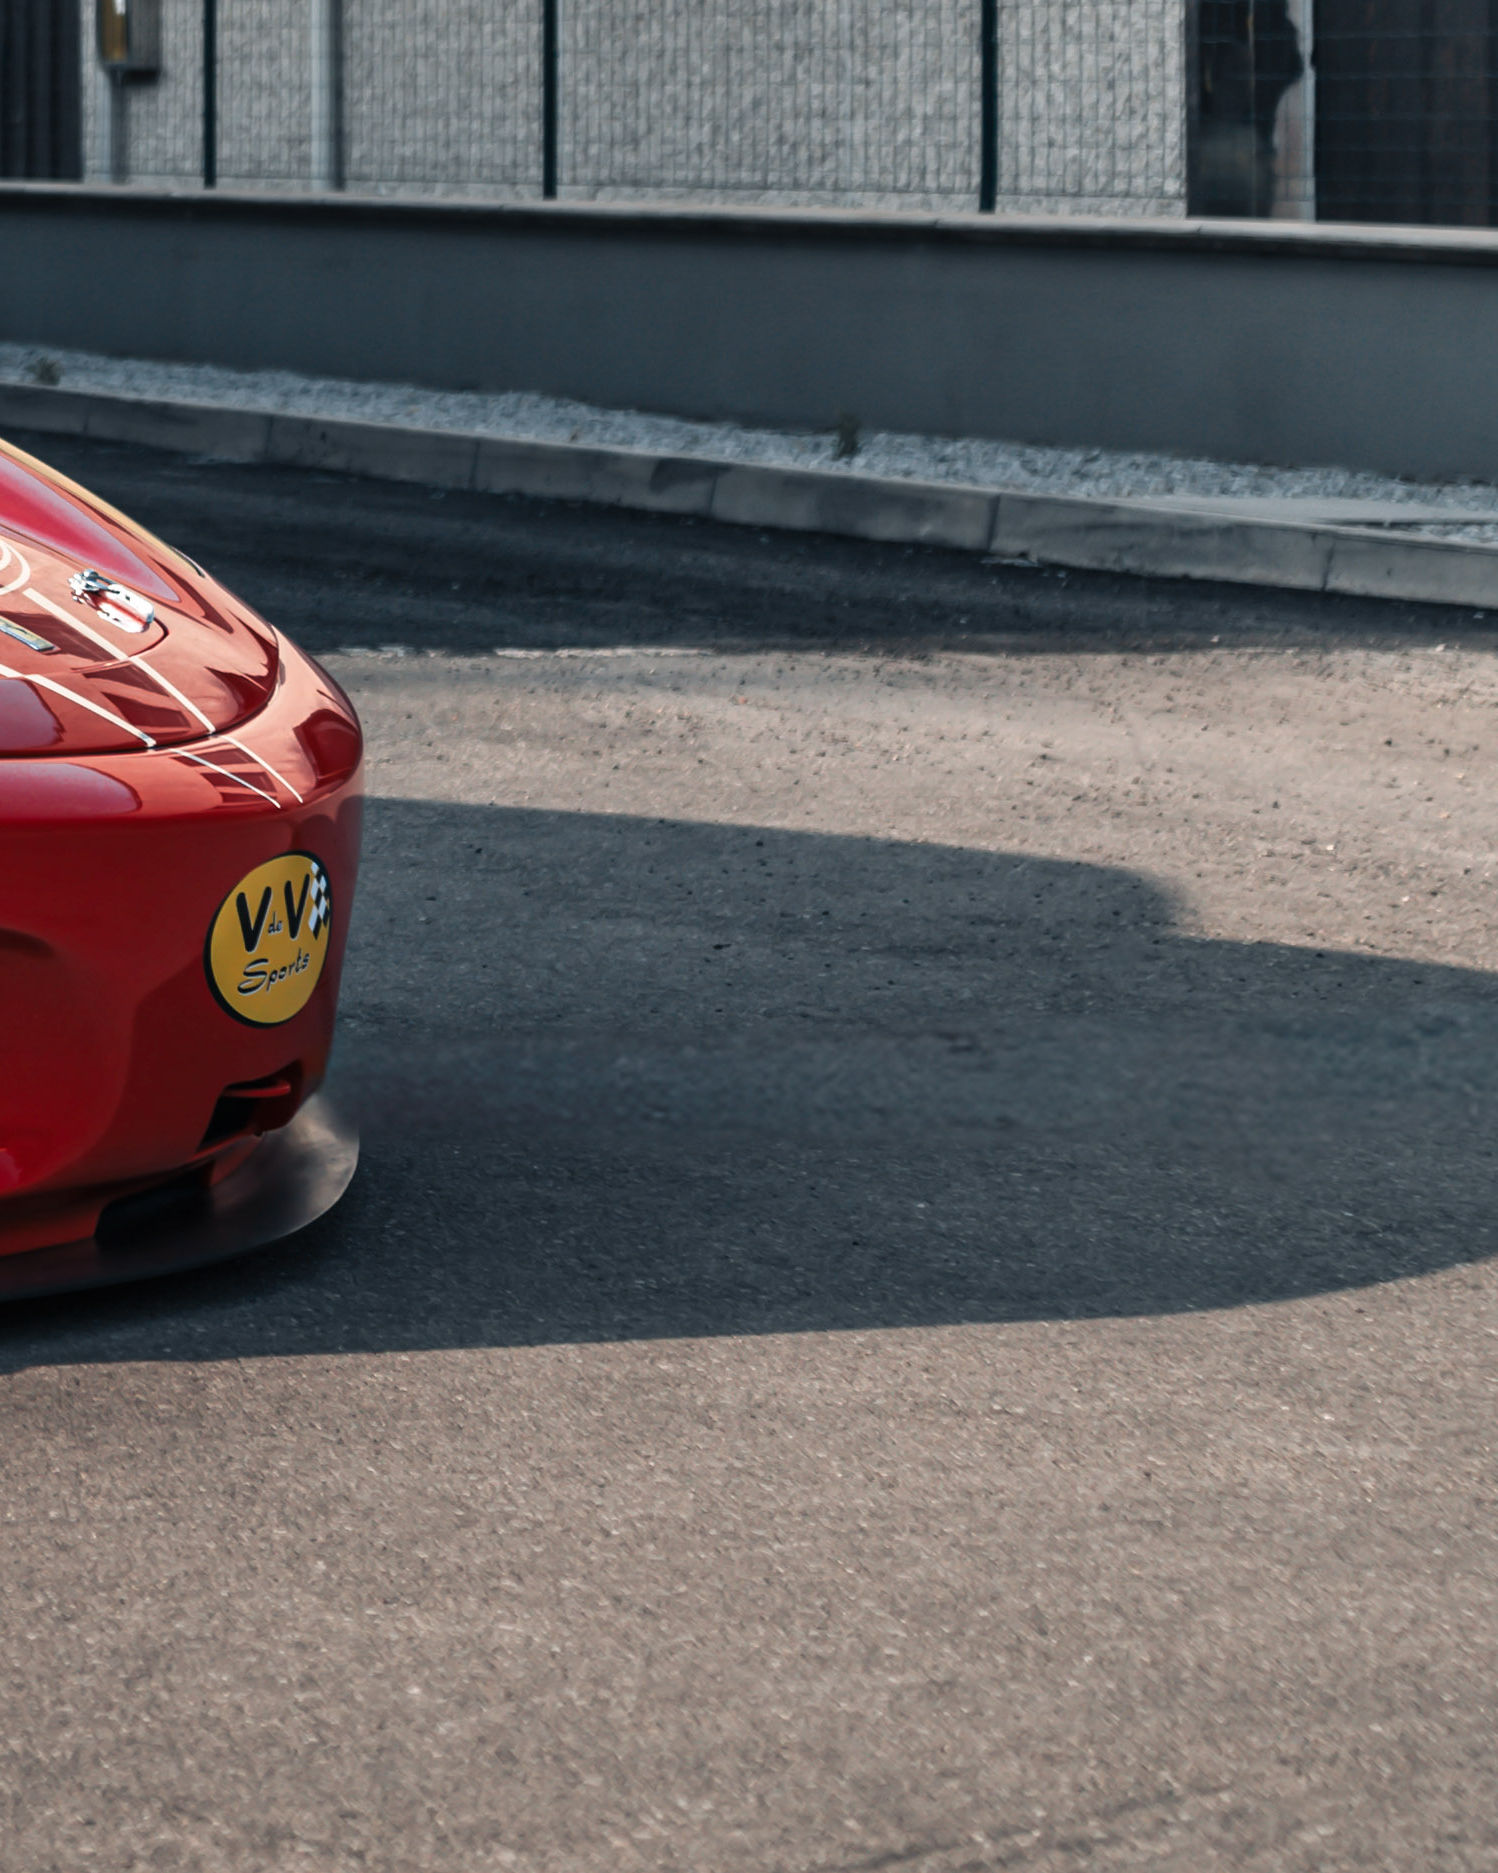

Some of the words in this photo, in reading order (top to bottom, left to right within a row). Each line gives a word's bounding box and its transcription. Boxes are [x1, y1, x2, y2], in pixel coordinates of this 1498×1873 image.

[236, 886, 272, 953] V
[284, 873, 310, 940] V
[237, 947, 310, 995] Sports
